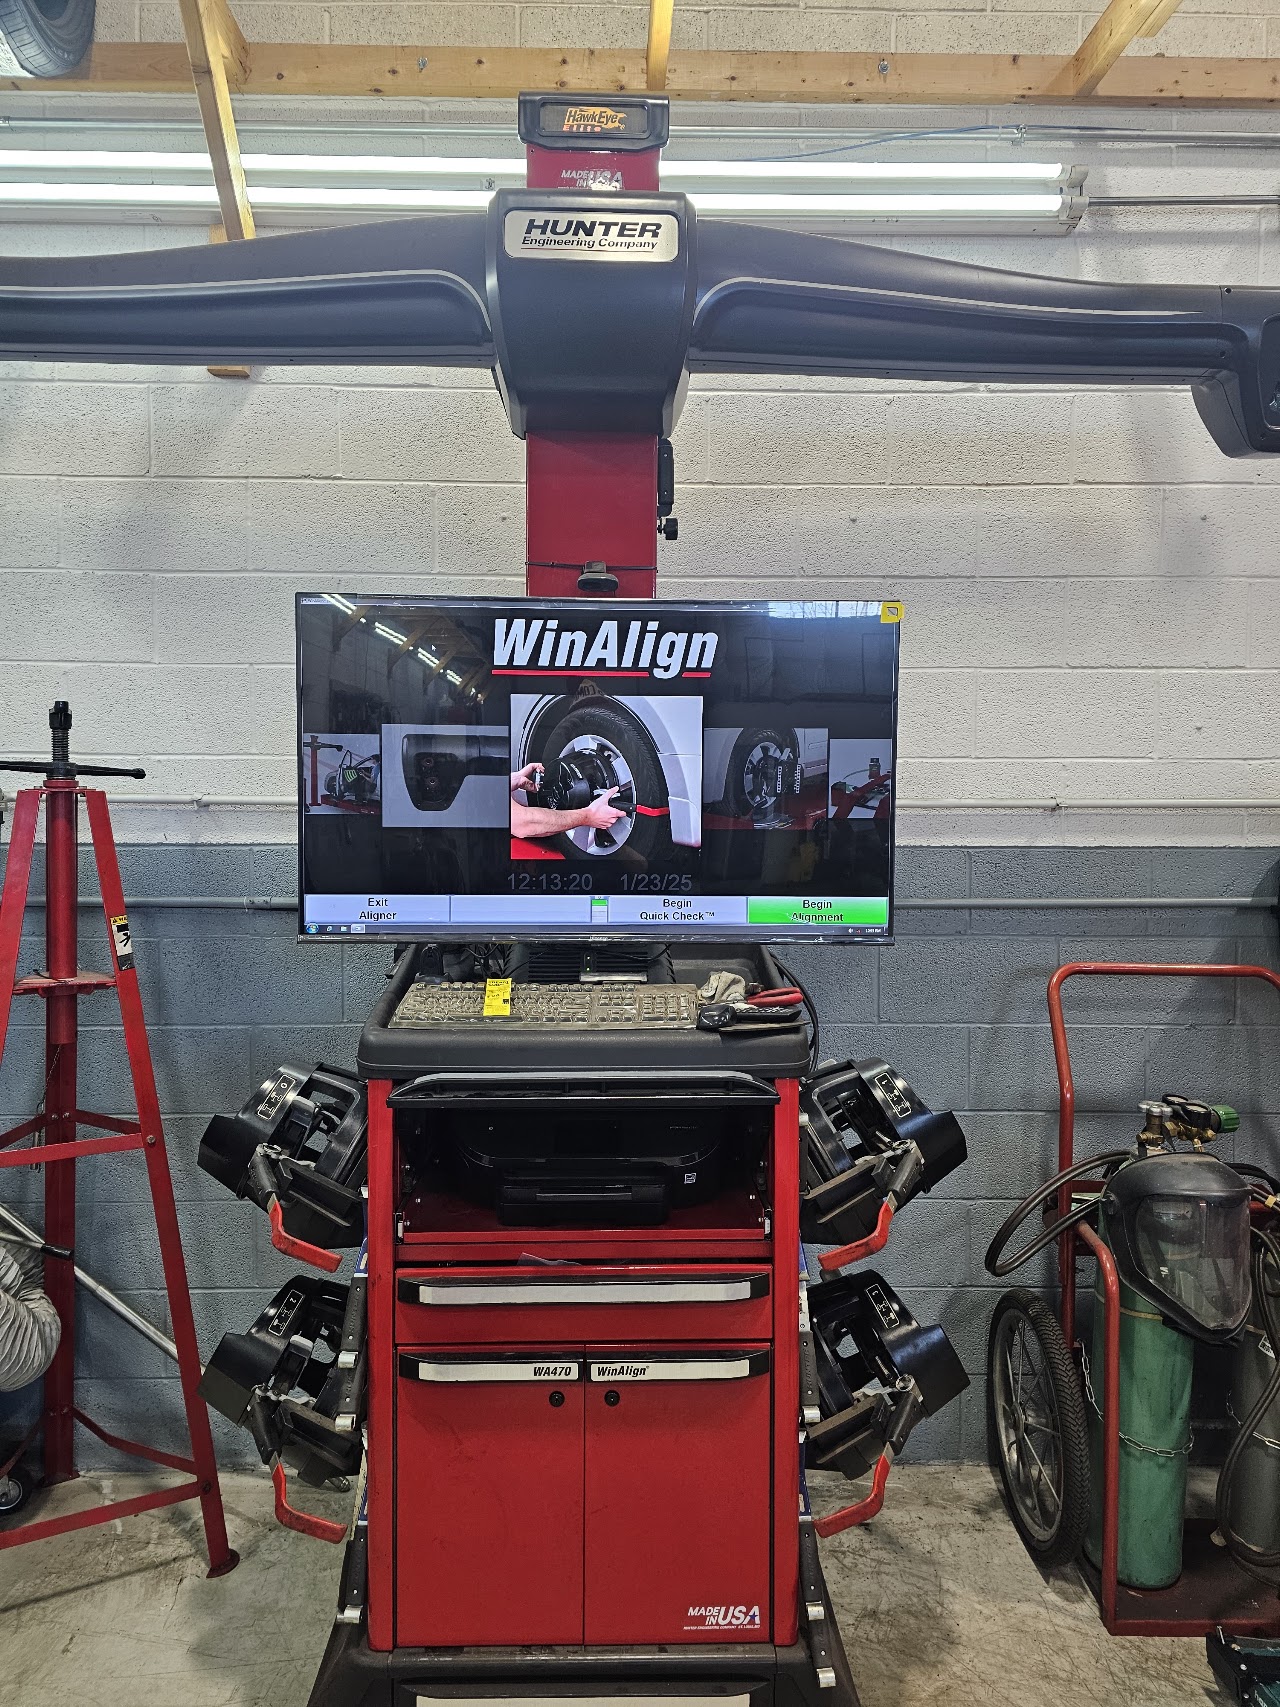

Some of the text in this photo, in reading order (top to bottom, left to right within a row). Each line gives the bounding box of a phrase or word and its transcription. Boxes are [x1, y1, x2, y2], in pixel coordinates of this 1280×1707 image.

[566, 110, 618, 125] HawkEye
[561, 170, 588, 178] MADE
[524, 218, 663, 239] HUNTER
[521, 236, 658, 250] Engineering Company
[493, 618, 719, 679] WinAlign
[507, 873, 692, 891] 12:13:20 1/23/25
[367, 898, 388, 907] Exit
[662, 899, 692, 910] Begin
[802, 899, 832, 911] Begin
[359, 910, 397, 921] Aligner
[640, 911, 669, 922] Quick
[791, 912, 844, 924] Alignment
[533, 1366, 572, 1377] WA470
[688, 1607, 720, 1616] MADE
[718, 1606, 760, 1625] USA
[705, 1616, 718, 1625] IN
